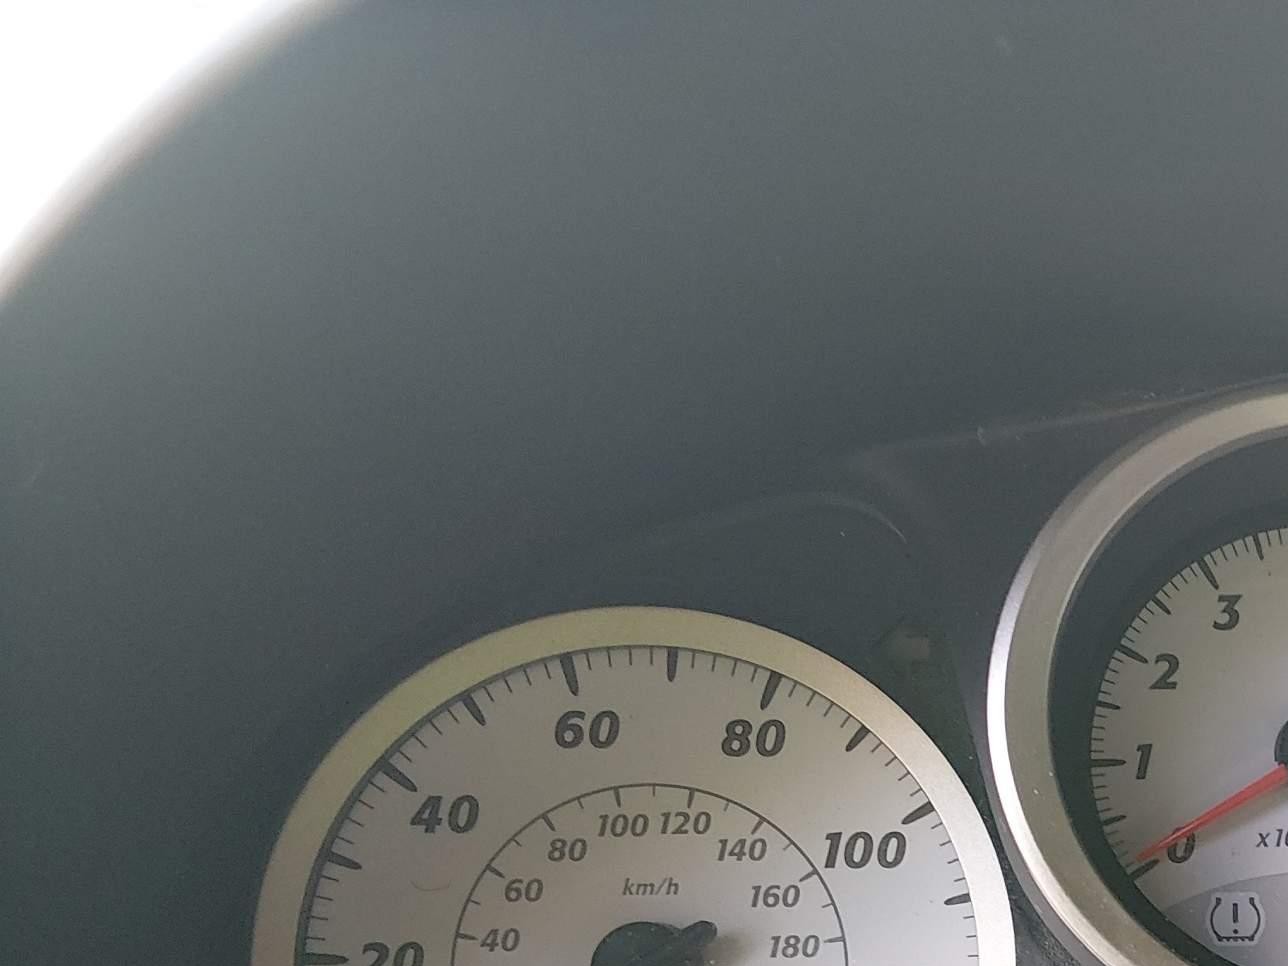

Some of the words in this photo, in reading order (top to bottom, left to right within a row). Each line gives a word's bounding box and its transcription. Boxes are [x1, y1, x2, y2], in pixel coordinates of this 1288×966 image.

[1212, 593, 1242, 629] 3
[1149, 653, 1180, 689] 2
[553, 710, 620, 748] 60
[720, 718, 786, 756] 80
[1135, 743, 1152, 778] 1
[410, 794, 479, 833] 40
[597, 813, 649, 838] 100
[659, 810, 711, 834] 120
[547, 838, 587, 862] 80
[717, 838, 767, 862] 140
[824, 829, 907, 868] 100
[504, 878, 543, 902] 60
[622, 876, 679, 896] km/h
[750, 883, 800, 907] 160
[480, 928, 519, 951] 40
[769, 935, 819, 957] 180
